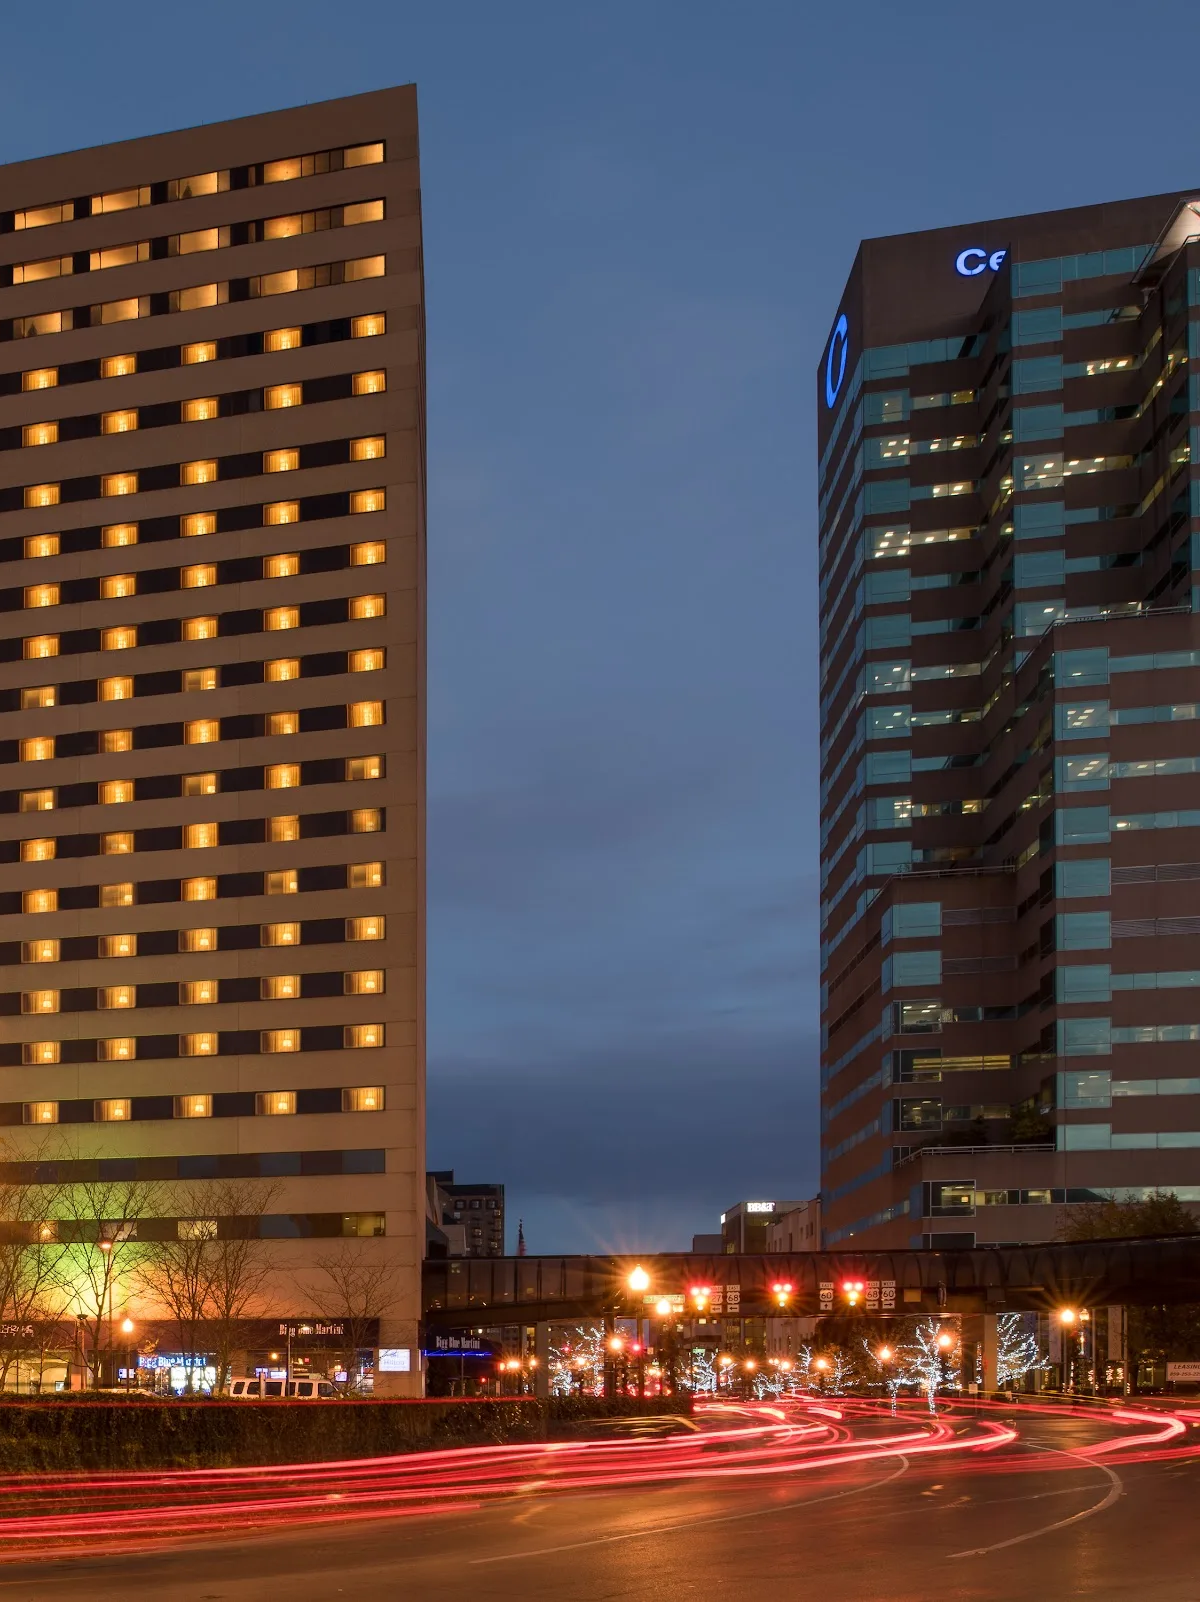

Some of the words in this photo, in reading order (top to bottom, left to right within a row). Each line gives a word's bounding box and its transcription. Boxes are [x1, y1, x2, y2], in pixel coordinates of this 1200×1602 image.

[747, 1202, 775, 1213] BB&T
[712, 1294, 722, 1302] 27
[728, 1294, 739, 1302] 68
[883, 1290, 894, 1298] 60
[315, 1323, 344, 1335] Martini
[435, 1335, 448, 1351] Bigg
[448, 1336, 460, 1348] Blue
[460, 1336, 481, 1350] Martini
